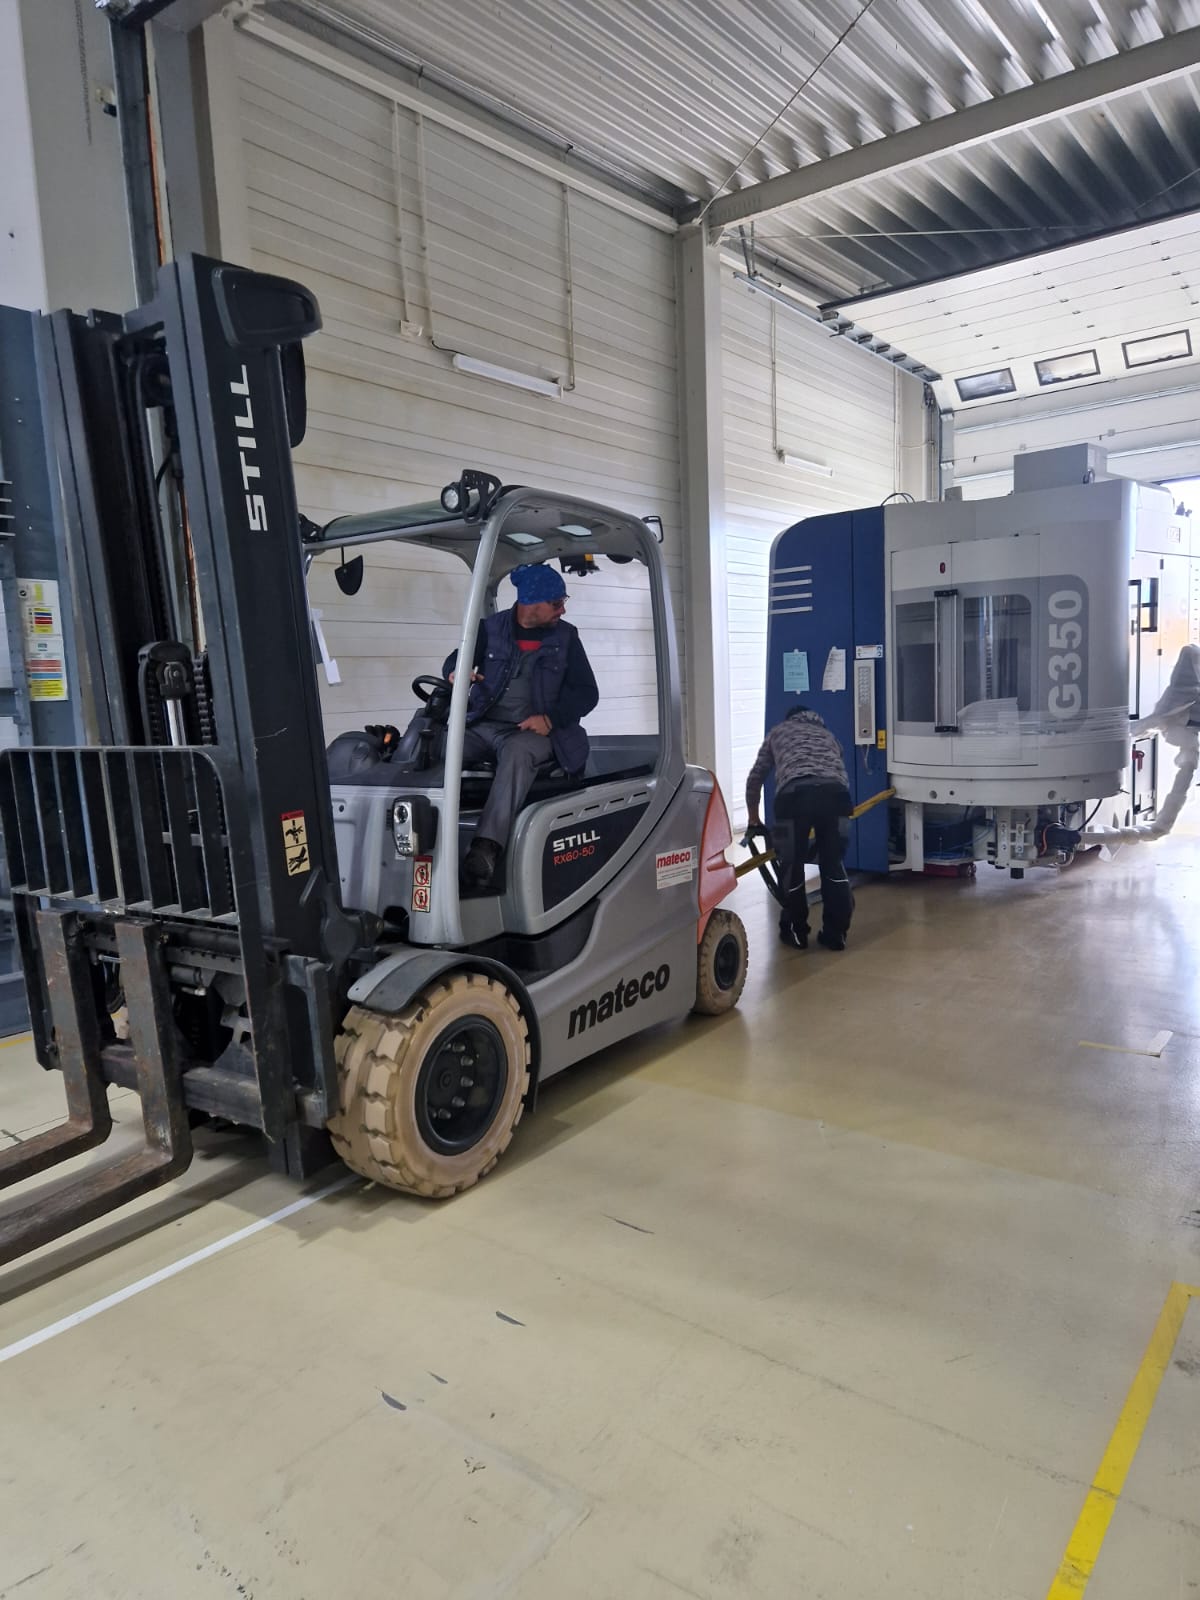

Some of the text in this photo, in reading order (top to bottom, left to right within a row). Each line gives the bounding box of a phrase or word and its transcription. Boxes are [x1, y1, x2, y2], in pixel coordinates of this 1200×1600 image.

[230, 364, 268, 531] STILL
[1048, 589, 1082, 719] G350
[552, 829, 601, 853] STILL
[553, 845, 595, 867] RX60-50
[656, 851, 691, 869] mateco
[567, 963, 671, 1040] mateco
